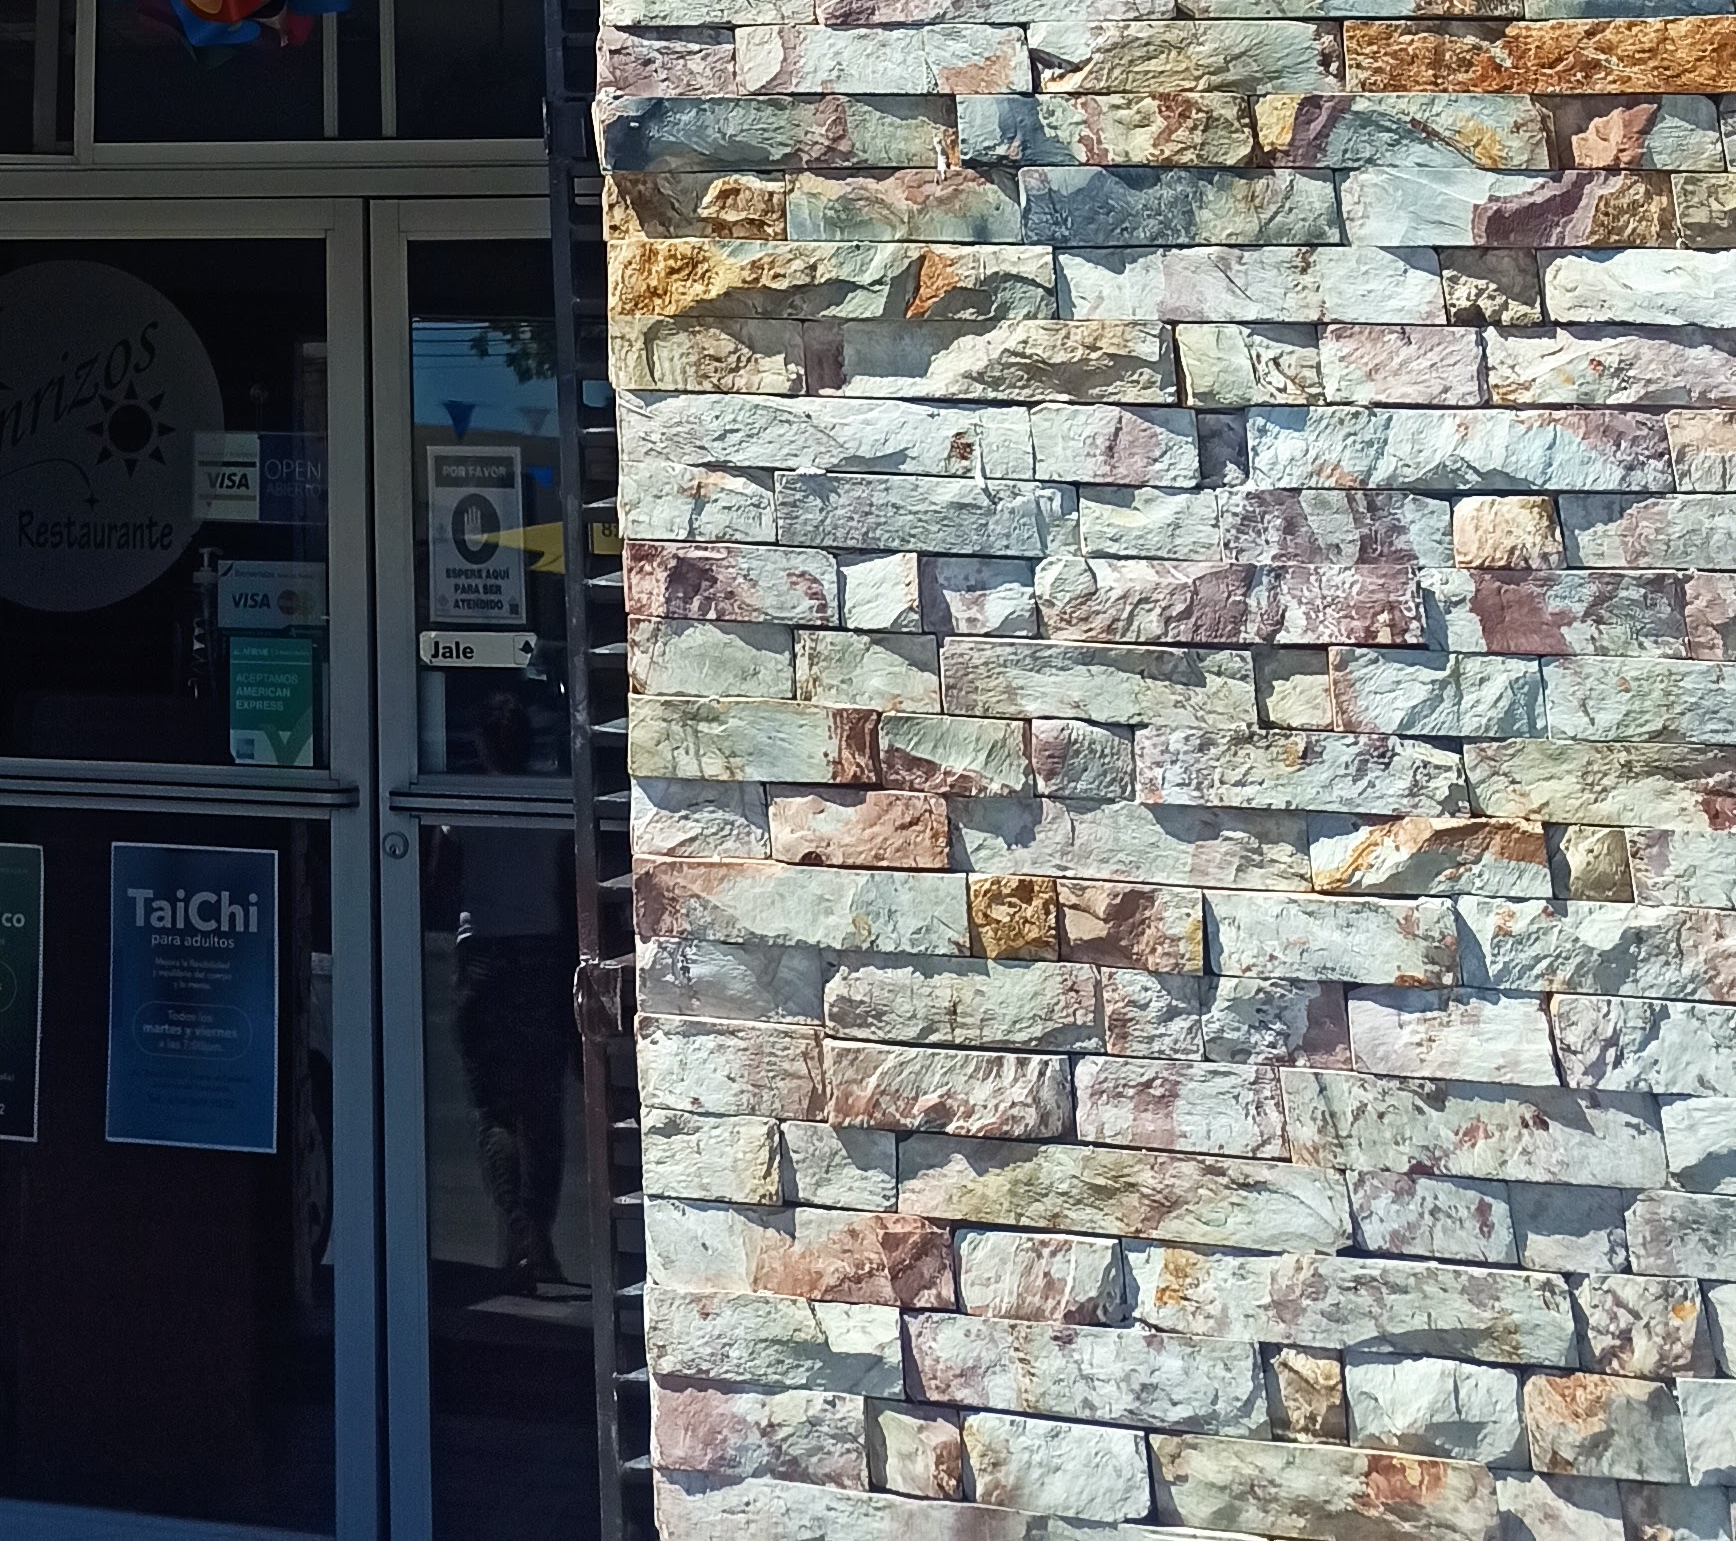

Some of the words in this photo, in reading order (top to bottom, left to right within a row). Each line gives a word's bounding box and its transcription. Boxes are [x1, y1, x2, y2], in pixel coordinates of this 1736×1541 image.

[264, 458, 321, 481] OPEN
[442, 465, 466, 477] POR
[468, 466, 507, 478] FAVOR
[205, 472, 250, 490] VISA
[266, 482, 322, 497] ABIERTO
[18, 510, 174, 551] Restaurante
[445, 568, 483, 580] ESPERE
[485, 567, 510, 580] AQUÍ
[454, 584, 480, 595] PARA
[482, 584, 502, 595] SER
[232, 592, 271, 609] VISA
[452, 598, 504, 610] ATENDIDO
[431, 641, 475, 660] Jale
[235, 673, 299, 685] ACEPTAMOS
[235, 686, 291, 698] AMERICAN
[235, 699, 284, 711] EXPRESS
[126, 888, 259, 933] TaiChi
[151, 932, 180, 948] para
[184, 931, 235, 949] adultos
[142, 1023, 182, 1036] martes
